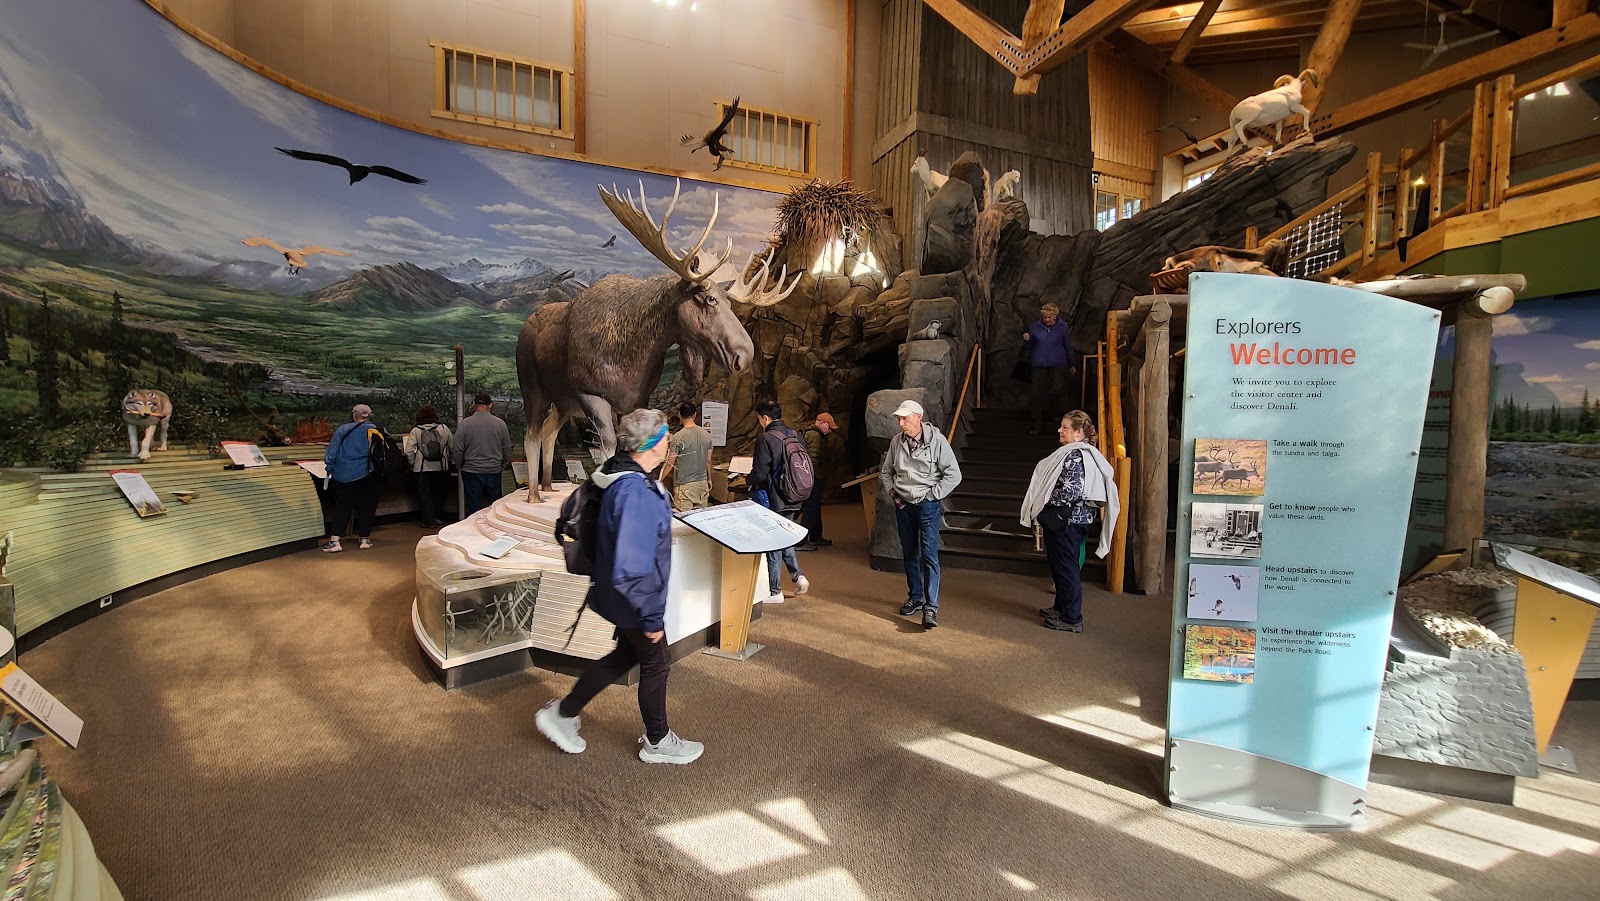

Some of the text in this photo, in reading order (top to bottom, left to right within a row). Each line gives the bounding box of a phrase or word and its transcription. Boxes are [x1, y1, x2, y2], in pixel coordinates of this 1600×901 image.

[1216, 318, 1301, 338] Explorers
[1230, 342, 1356, 365] Welcome
[1248, 378, 1271, 386] invite
[1275, 379, 1290, 388] you
[1306, 378, 1337, 388] explore
[1231, 390, 1244, 398] the
[1247, 390, 1274, 398] visitor
[1306, 390, 1322, 398] and
[1230, 402, 1298, 410] discover Denali.
[1321, 441, 1344, 449] through
[1322, 450, 1339, 458] taiga.
[1265, 565, 1284, 573] Head
[1287, 566, 1317, 576] upstairs
[1296, 629, 1322, 637] theater
[1325, 630, 1355, 639] upstairs
[1270, 637, 1302, 645] experience
